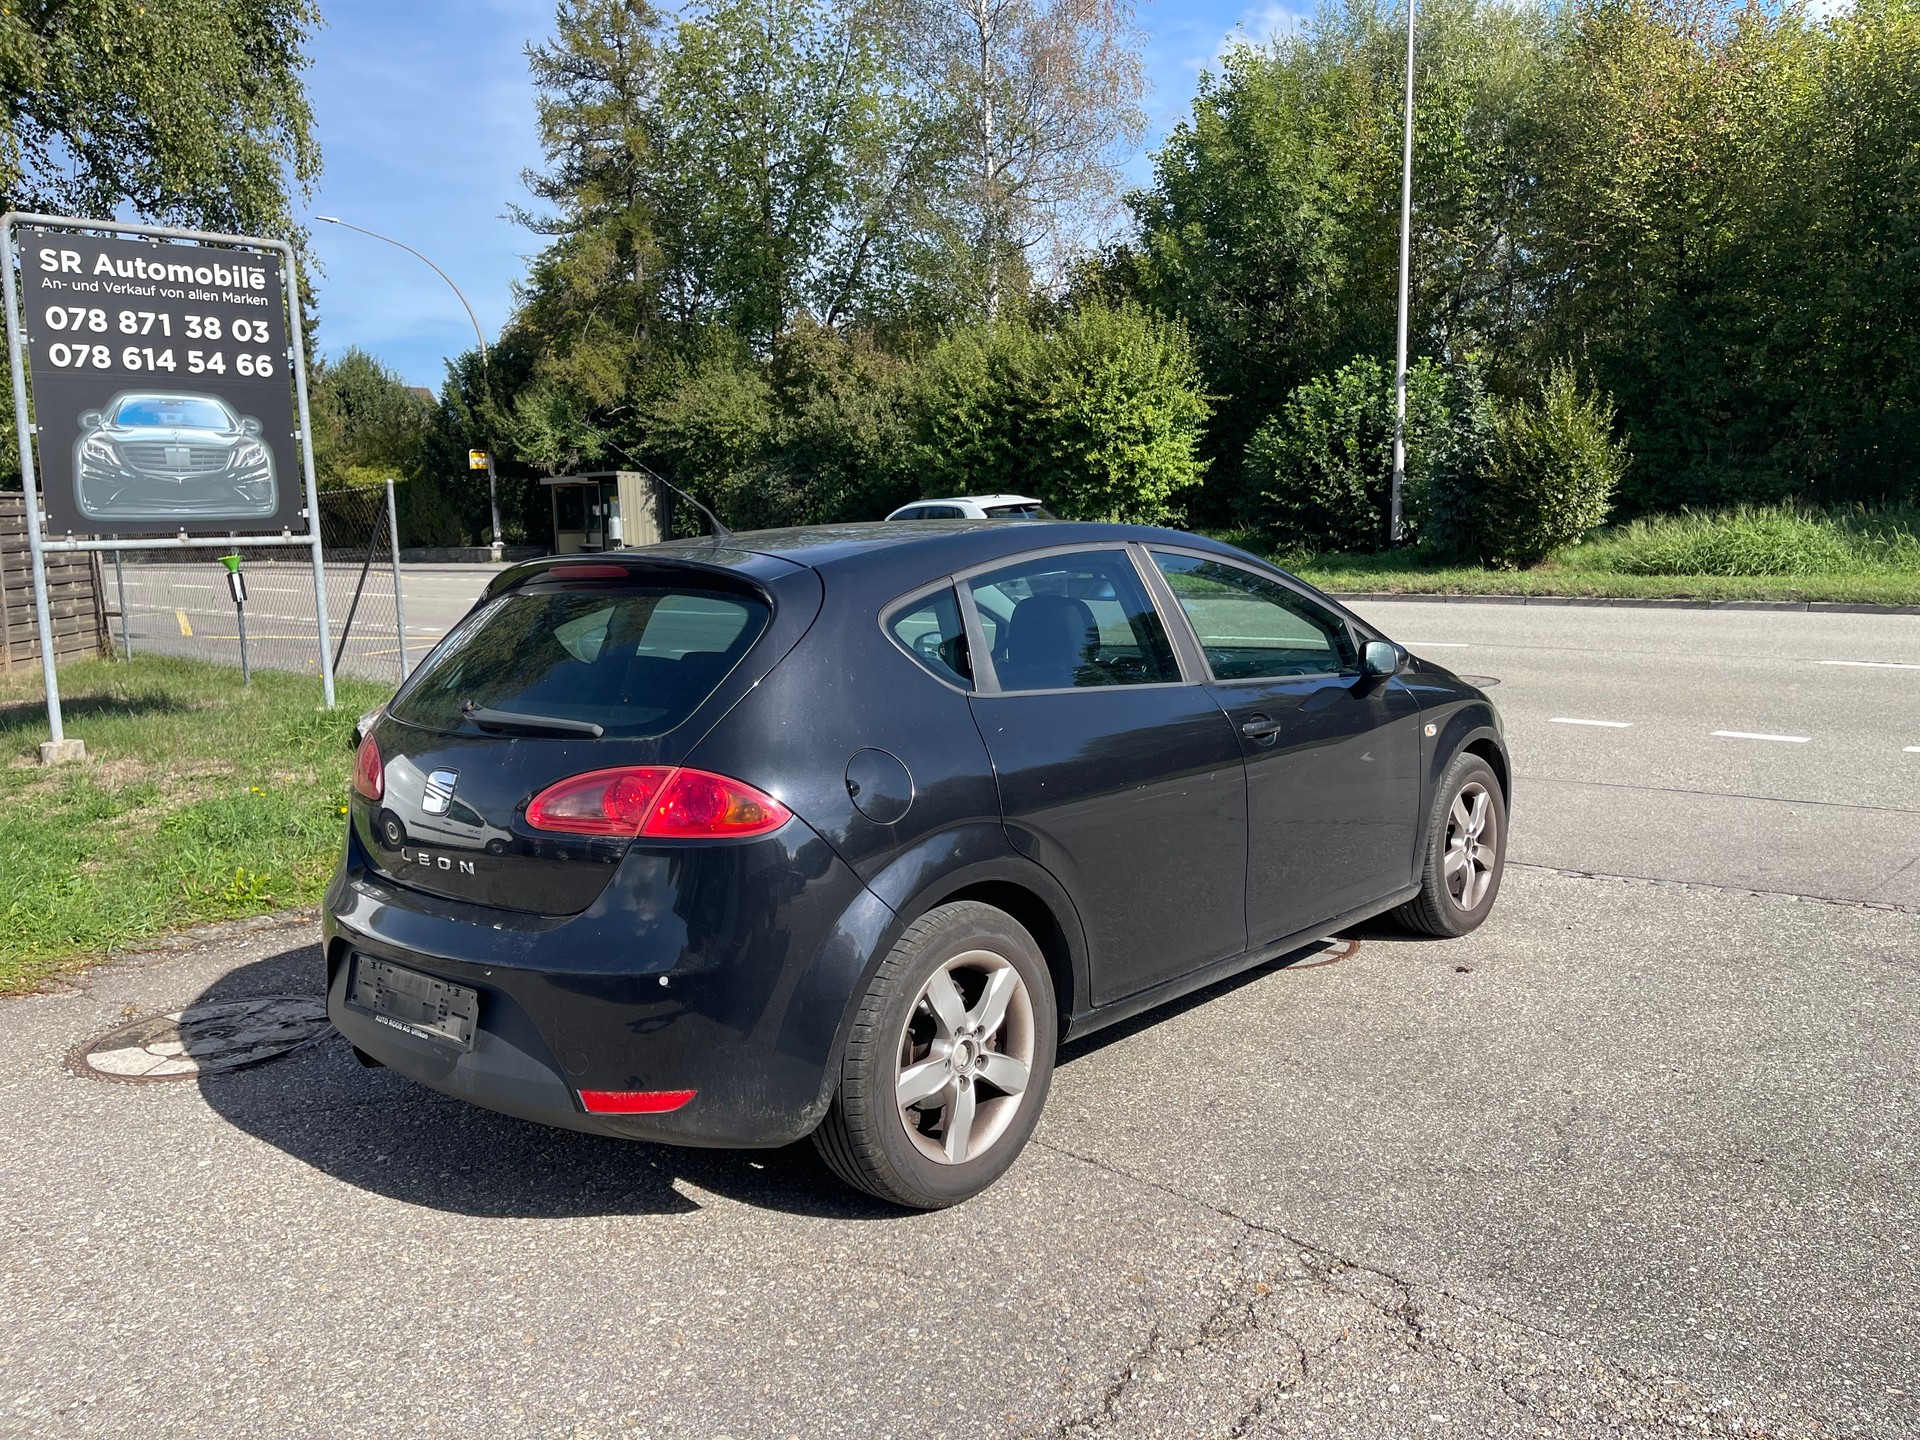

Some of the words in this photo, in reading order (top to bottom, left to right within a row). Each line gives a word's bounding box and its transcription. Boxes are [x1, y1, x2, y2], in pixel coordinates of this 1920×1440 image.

[39, 248, 83, 274] SR
[93, 252, 266, 290] Automobile
[41, 276, 68, 290] An-
[71, 280, 99, 293] und
[102, 281, 157, 298] Verkauf
[159, 287, 185, 299] von
[187, 289, 219, 302] allen
[222, 291, 269, 307] Marken
[45, 305, 108, 333] 078
[118, 310, 171, 337] 871
[184, 314, 223, 340] 38
[231, 318, 270, 344] 03
[48, 342, 112, 370] 078
[122, 346, 177, 372] 614
[187, 350, 227, 375] 54
[235, 353, 274, 378] 66
[401, 847, 475, 876] LEON
[375, 1014, 389, 1025] AUTO
[402, 1024, 411, 1033] AG
